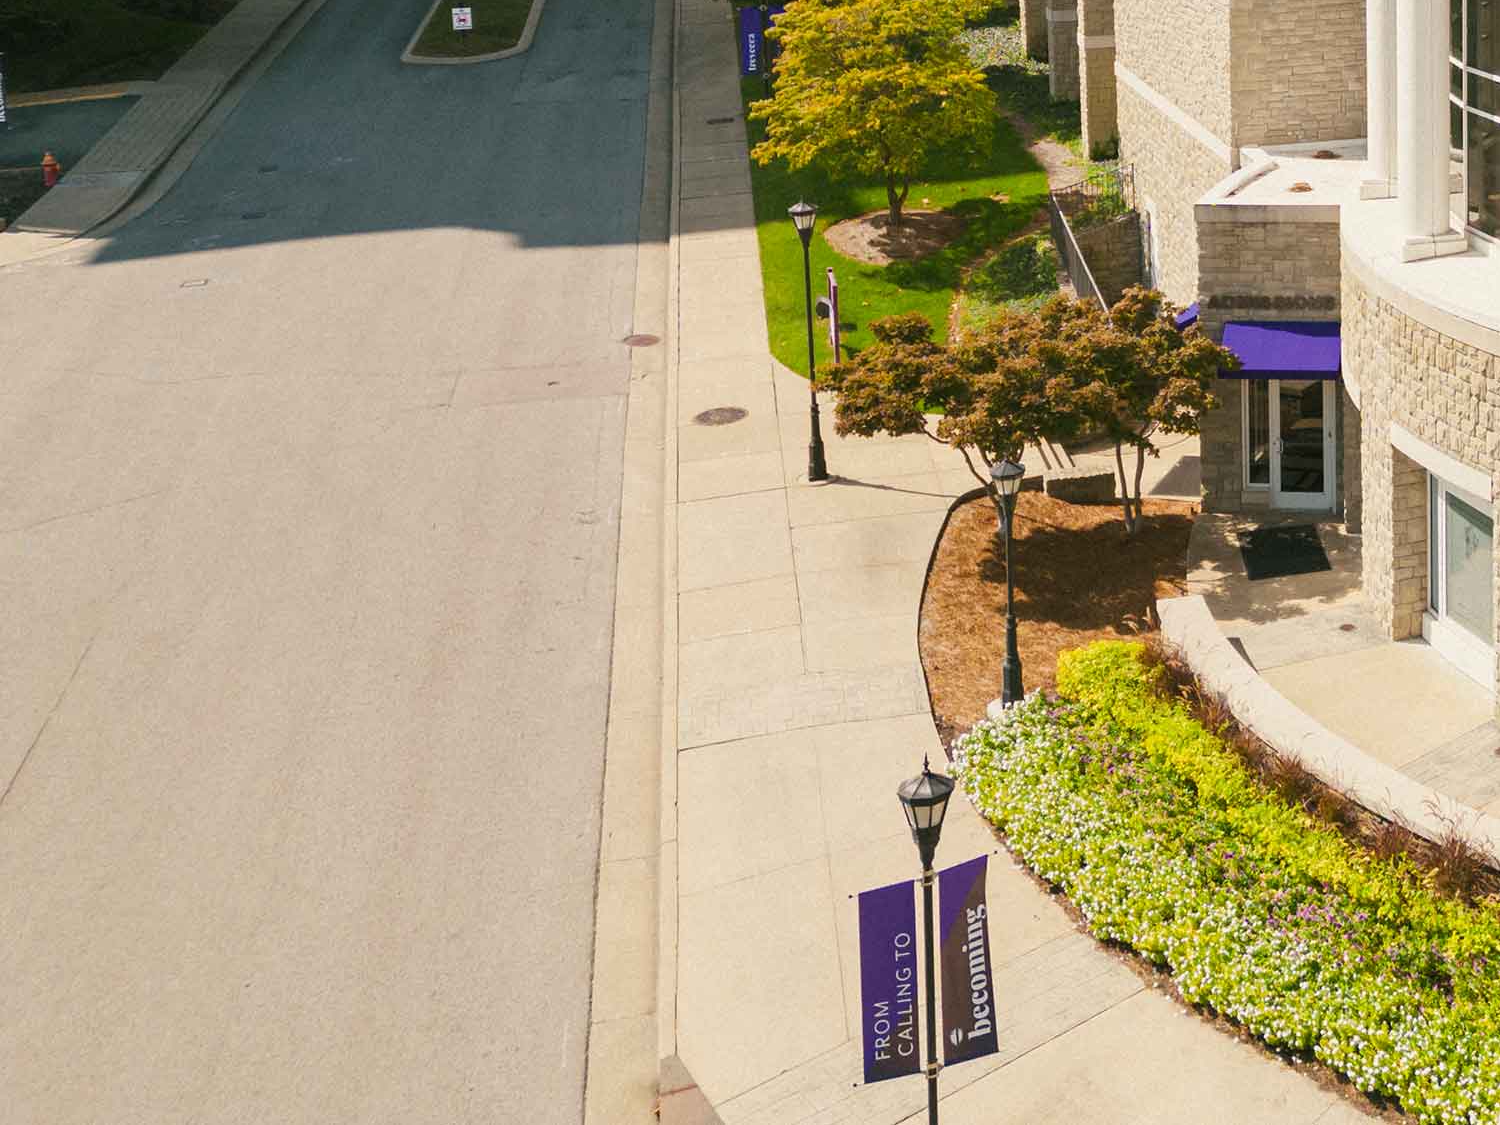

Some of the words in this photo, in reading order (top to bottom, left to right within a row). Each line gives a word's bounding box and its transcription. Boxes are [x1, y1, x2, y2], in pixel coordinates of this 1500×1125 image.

[894, 932, 911, 962] TO
[962, 904, 991, 1039] becoming
[874, 1001, 891, 1061] FROM
[896, 967, 914, 1057] CALLING
